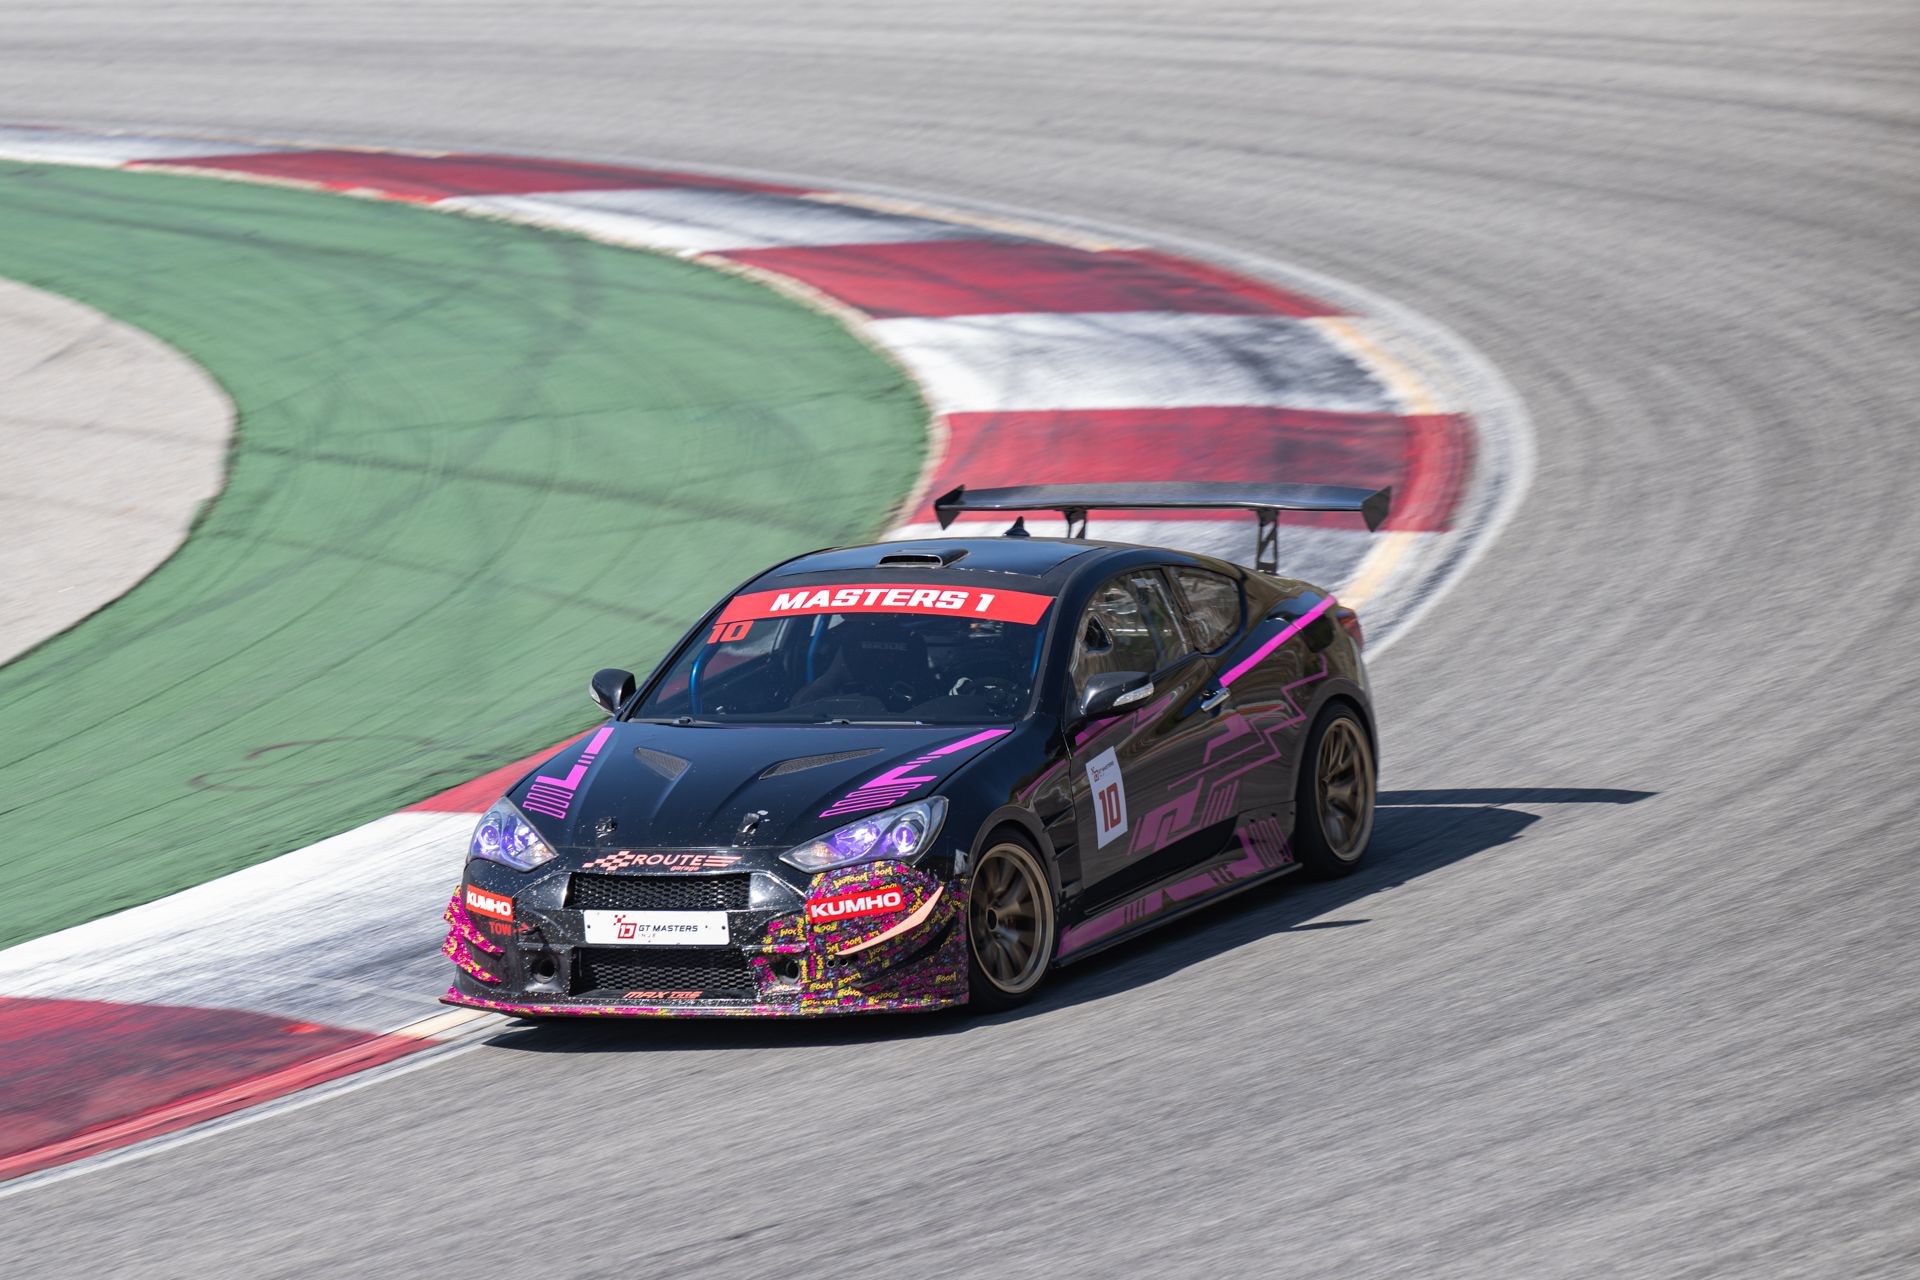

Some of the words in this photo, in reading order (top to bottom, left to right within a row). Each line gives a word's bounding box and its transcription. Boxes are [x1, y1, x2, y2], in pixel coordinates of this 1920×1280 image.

[770, 588, 970, 612] MASTERS
[975, 593, 996, 612] 1
[707, 621, 754, 644] 10
[1098, 782, 1121, 832] 10
[632, 854, 703, 866] ROUTE
[467, 891, 512, 916] KUMHO
[811, 892, 901, 918] KUMHO
[489, 921, 512, 937] TOW
[639, 924, 651, 932] GT
[653, 924, 699, 932] MASTERS
[623, 991, 669, 999] MAX
